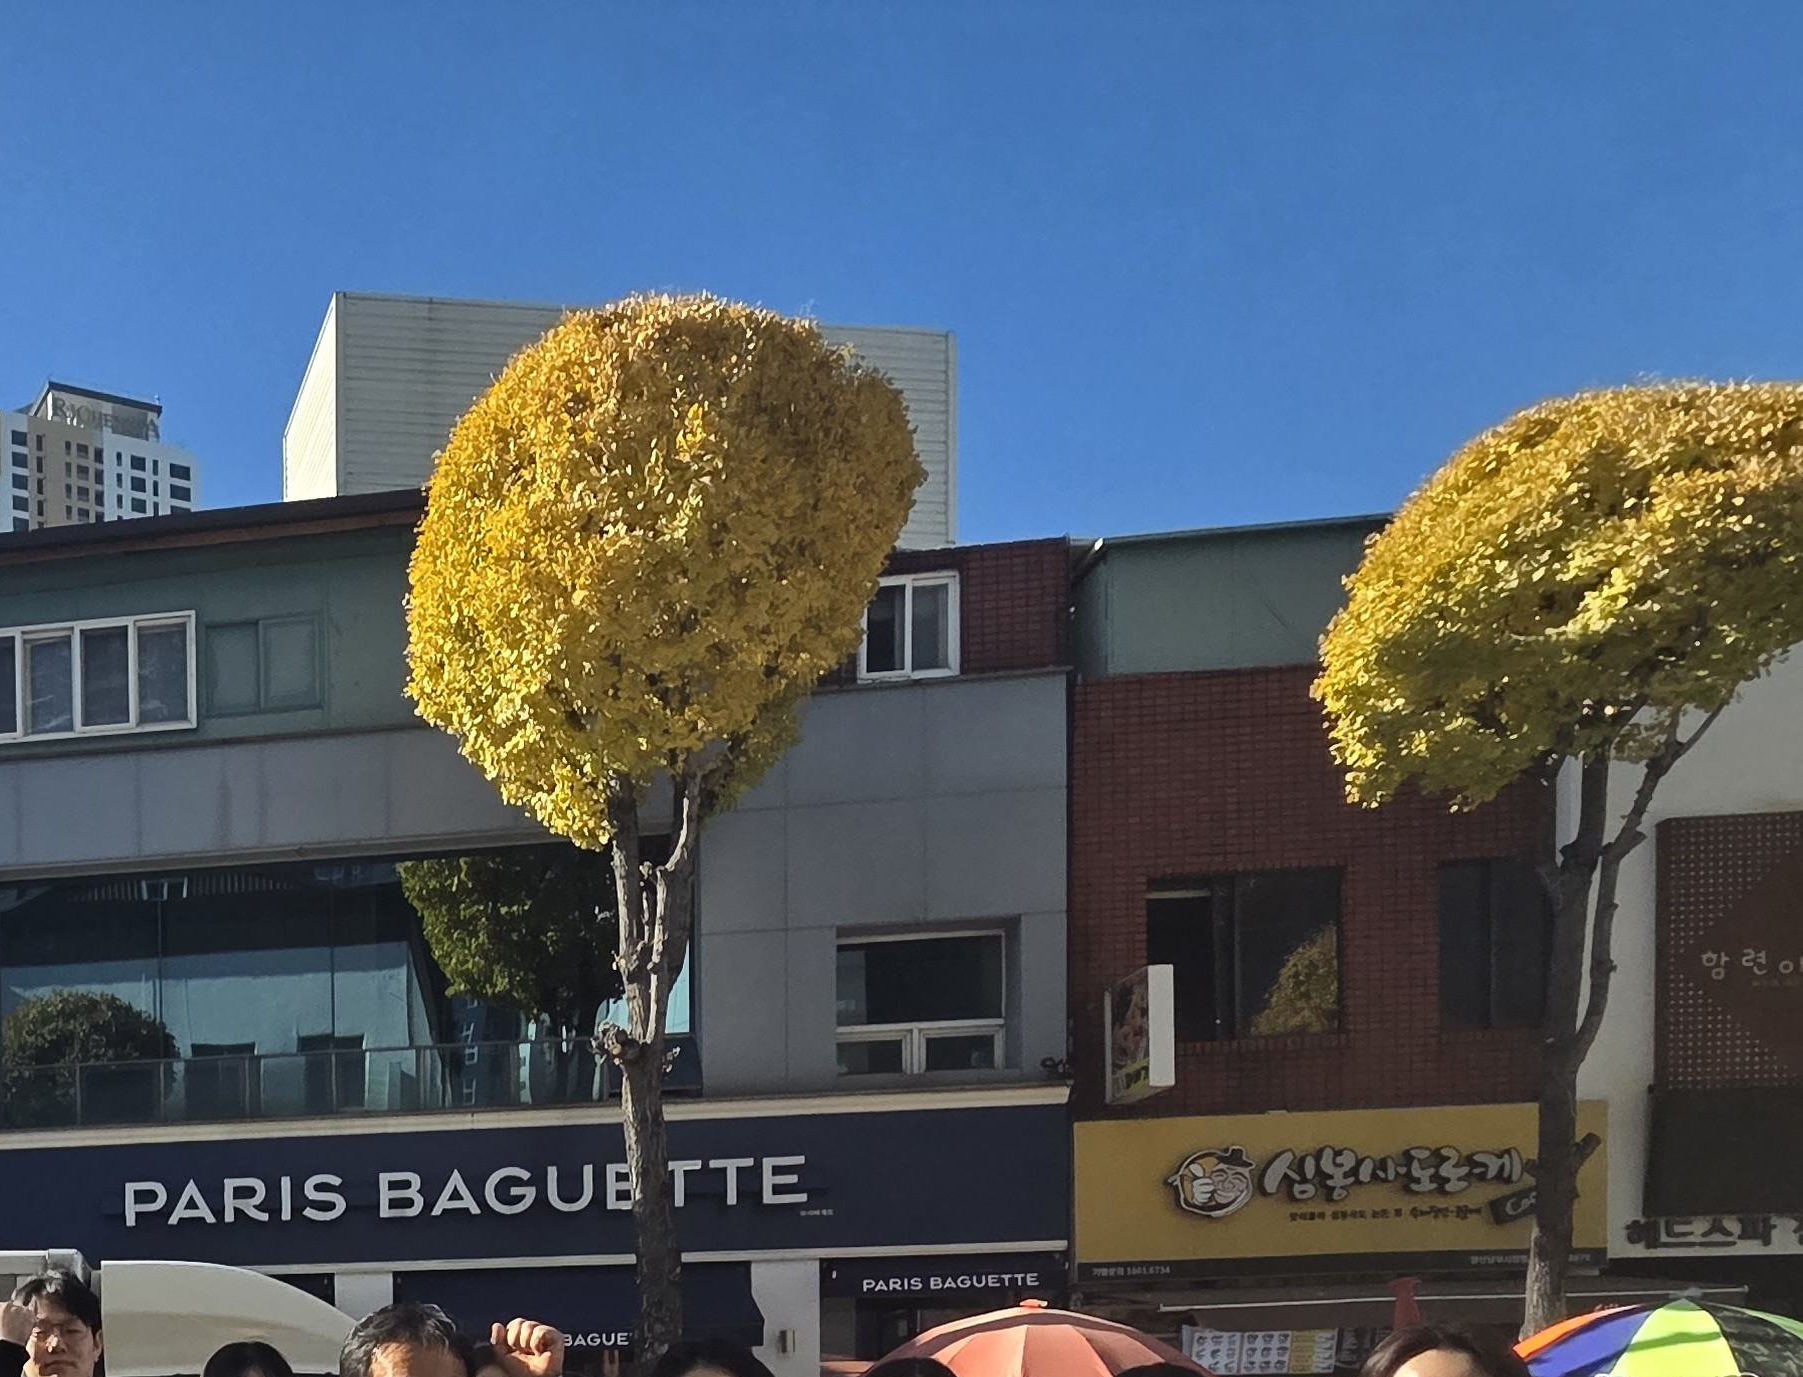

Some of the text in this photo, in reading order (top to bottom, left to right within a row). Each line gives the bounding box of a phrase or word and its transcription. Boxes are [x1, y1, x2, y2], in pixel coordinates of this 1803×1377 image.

[124, 1155, 808, 1227] PARIS BAGUETTE
[1624, 1216, 1777, 1249] 헤드스파
[863, 1273, 1040, 1292] PARIS BAGUETTE
[563, 1332, 632, 1347] BAGUE
